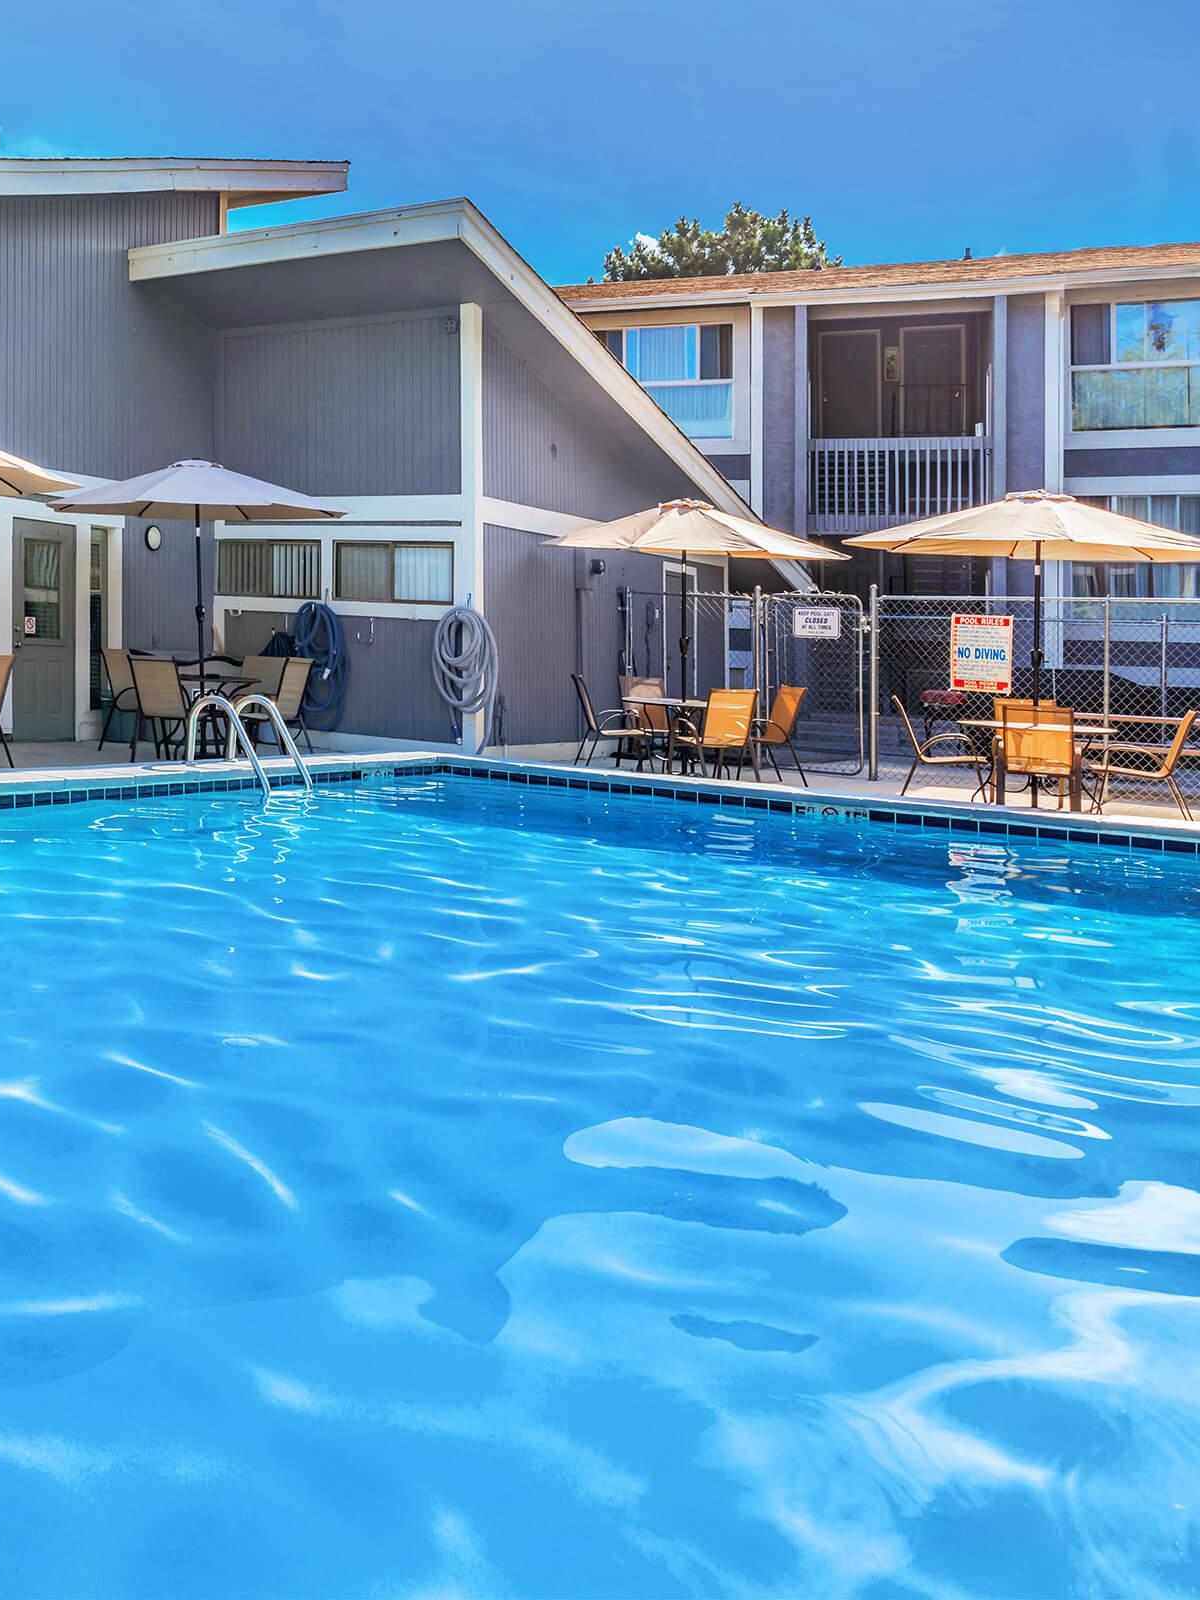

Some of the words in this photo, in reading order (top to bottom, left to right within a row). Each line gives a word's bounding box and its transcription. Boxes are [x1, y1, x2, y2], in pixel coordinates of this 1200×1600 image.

[804, 616, 828, 624] CLOSED
[959, 616, 979, 625] POOL
[980, 617, 1005, 626] RULES
[957, 646, 971, 659] NO
